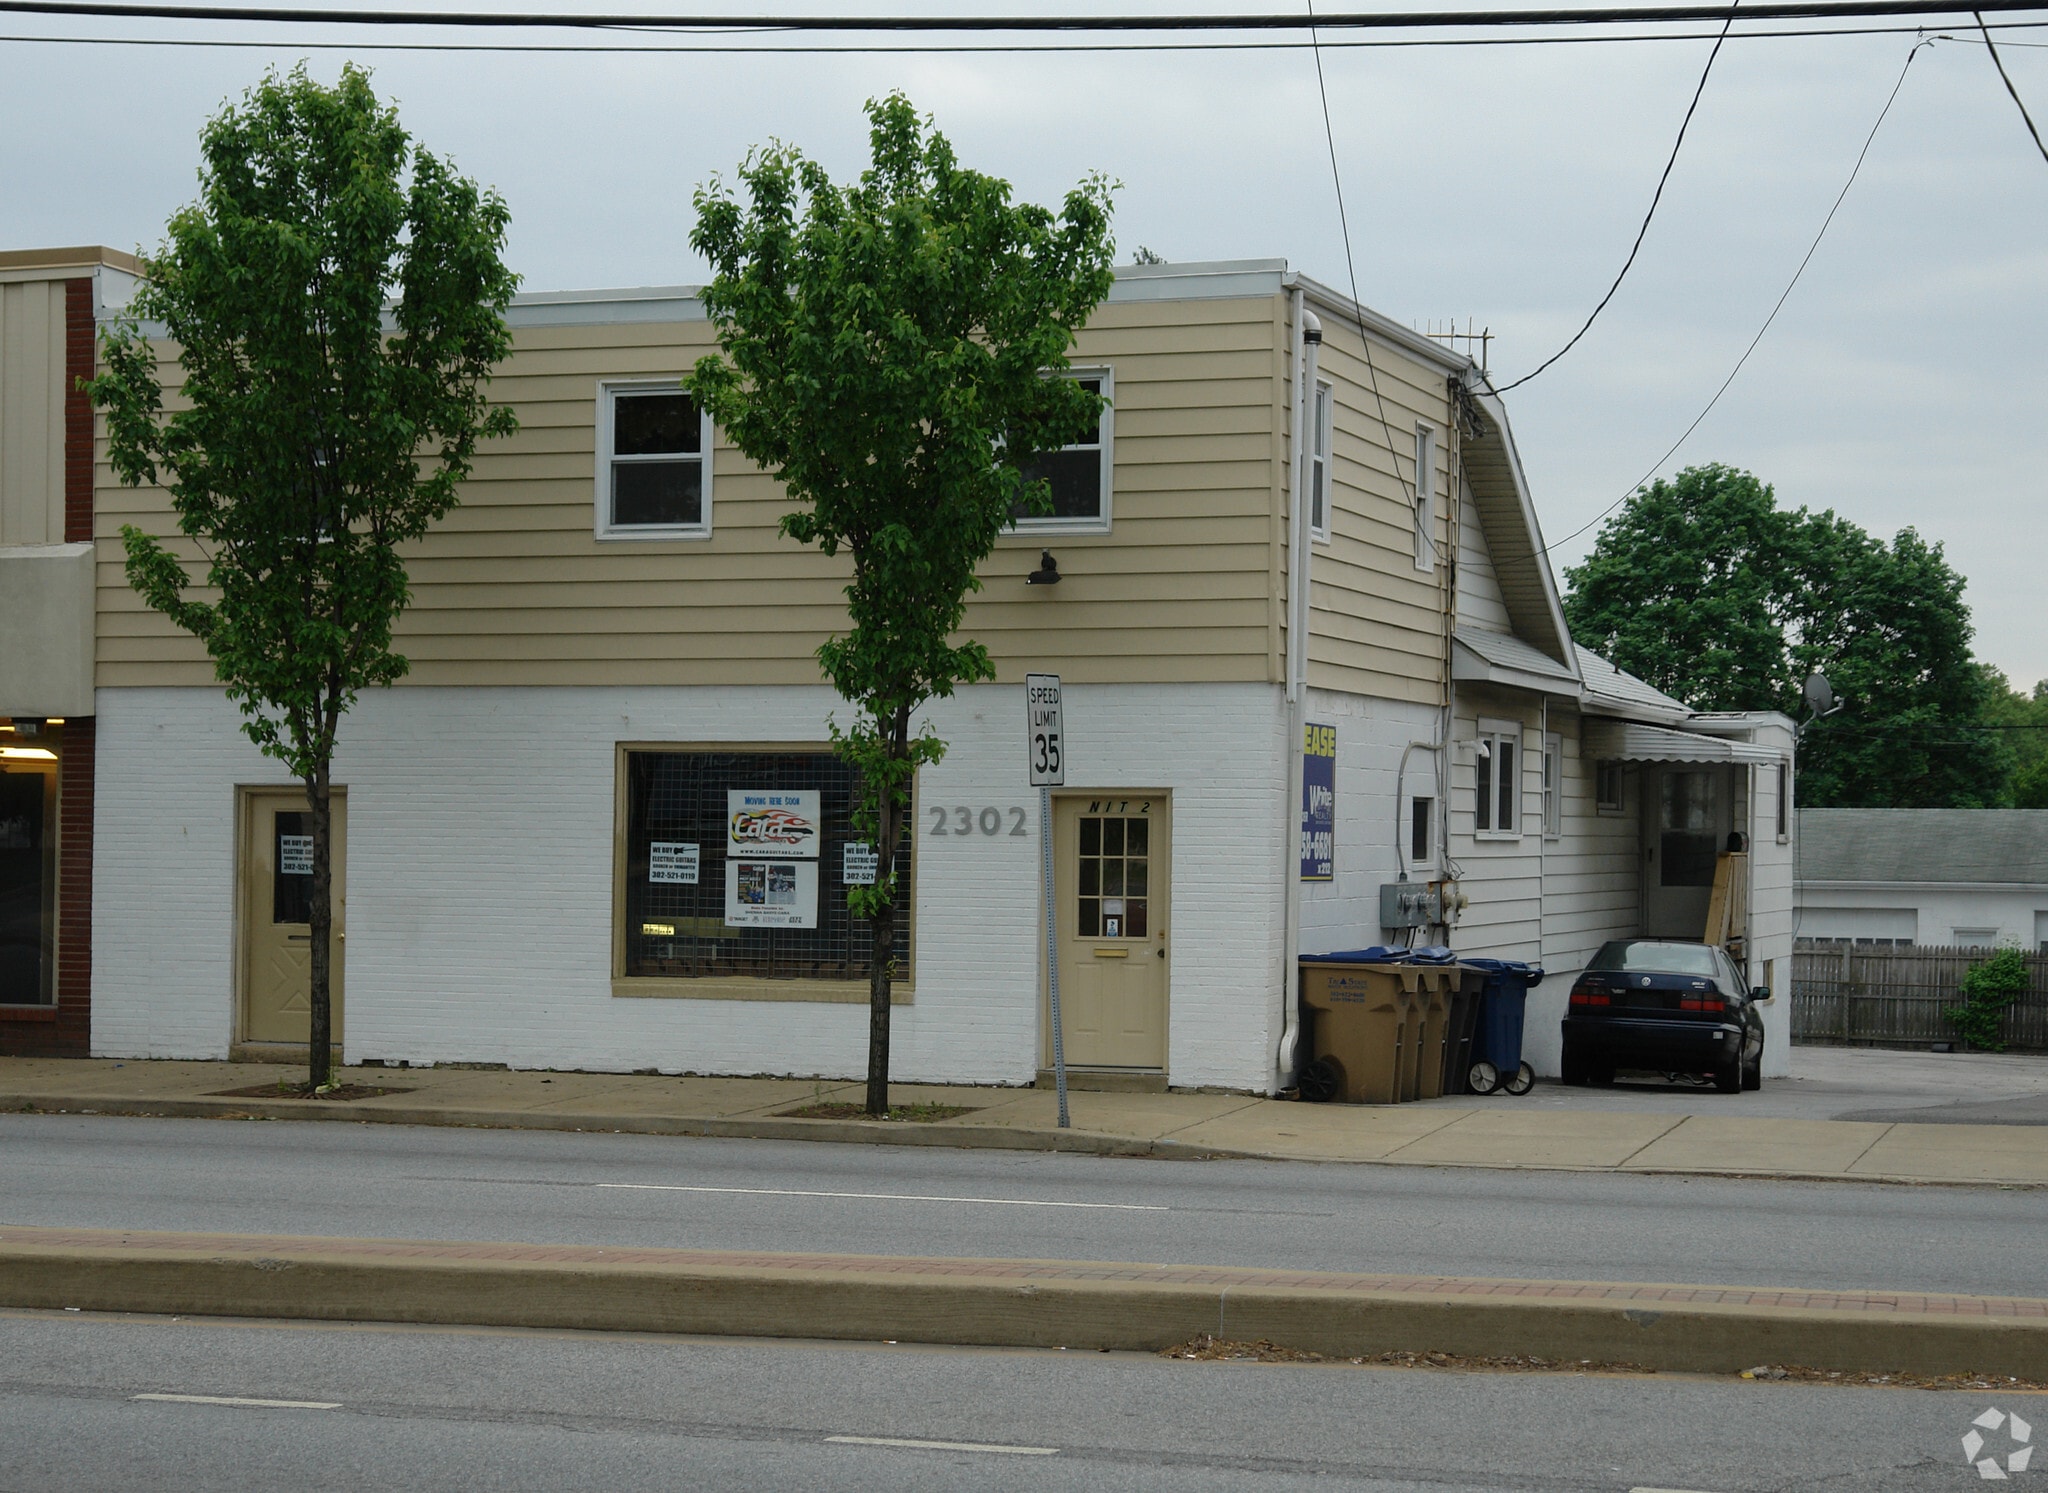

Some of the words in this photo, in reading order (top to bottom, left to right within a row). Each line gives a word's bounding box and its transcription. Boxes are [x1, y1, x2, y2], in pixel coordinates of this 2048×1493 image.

[1030, 687, 1059, 704] SPEED
[1034, 710, 1057, 727] LIMIT
[1304, 725, 1335, 757] EASE
[1034, 733, 1060, 774] 35
[1141, 801, 1151, 813] 2
[929, 806, 1027, 836] 2302
[1301, 831, 1332, 860] 58-6681
[652, 855, 675, 863] ELECTRIC
[675, 856, 697, 864] GUITARS
[651, 871, 696, 880] 302-521-0119
[845, 872, 875, 880] 302-521-
